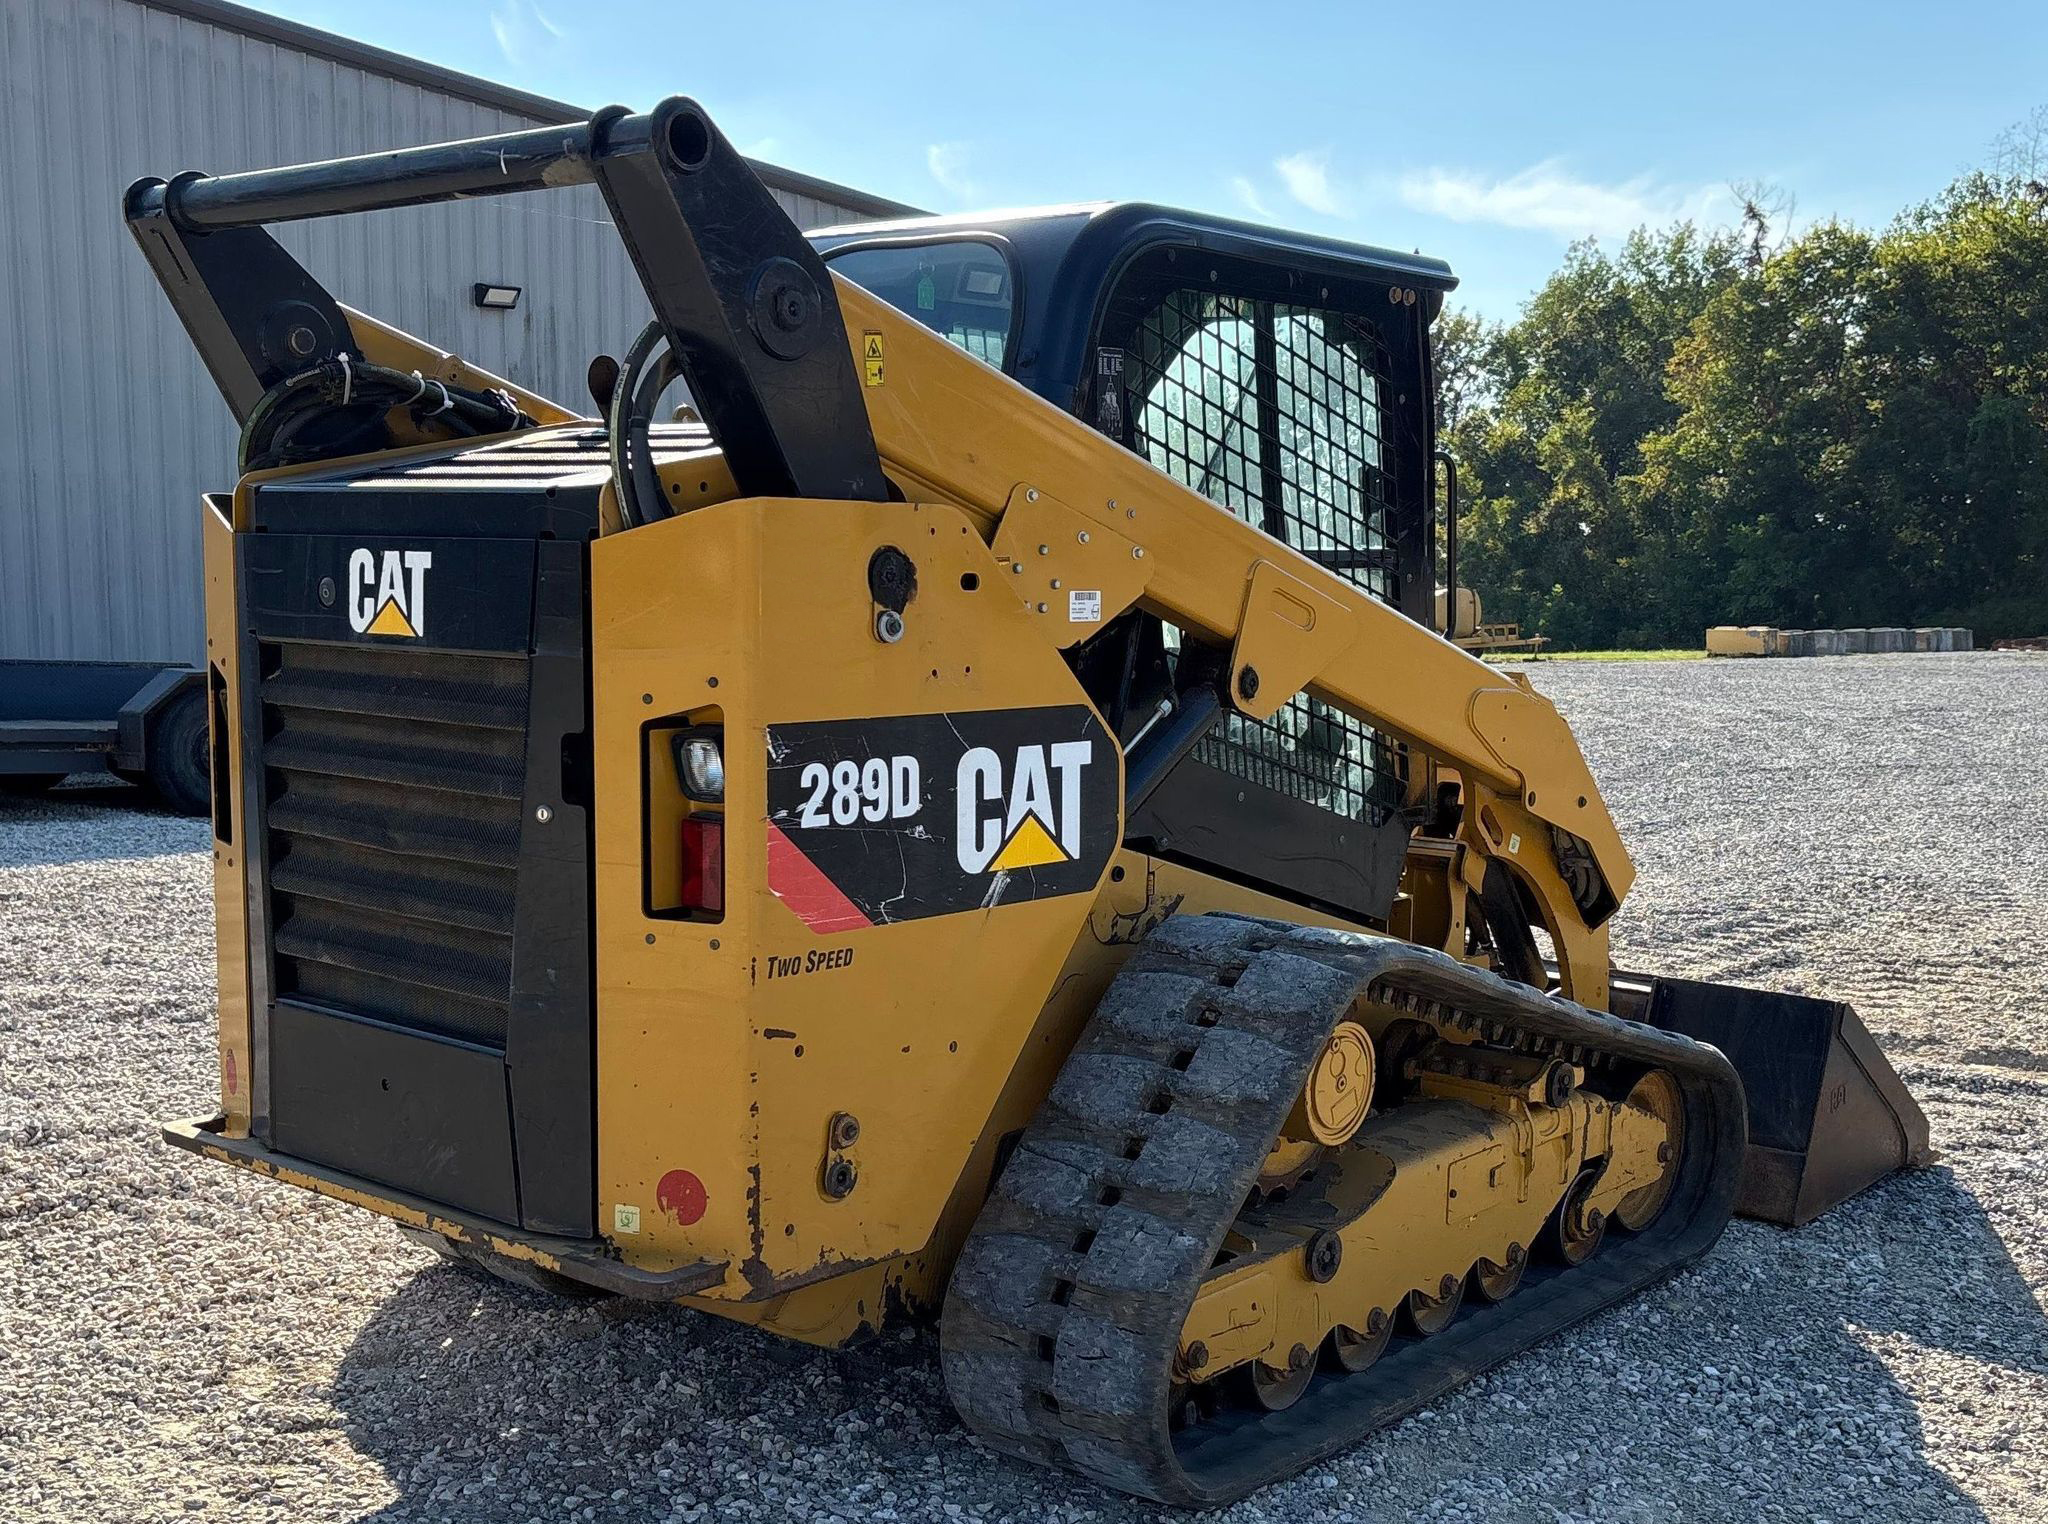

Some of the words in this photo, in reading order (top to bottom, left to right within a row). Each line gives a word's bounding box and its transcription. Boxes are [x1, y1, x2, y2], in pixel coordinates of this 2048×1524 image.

[349, 548, 432, 638] CAT
[800, 755, 920, 829] 289D
[957, 740, 1092, 875] CAT
